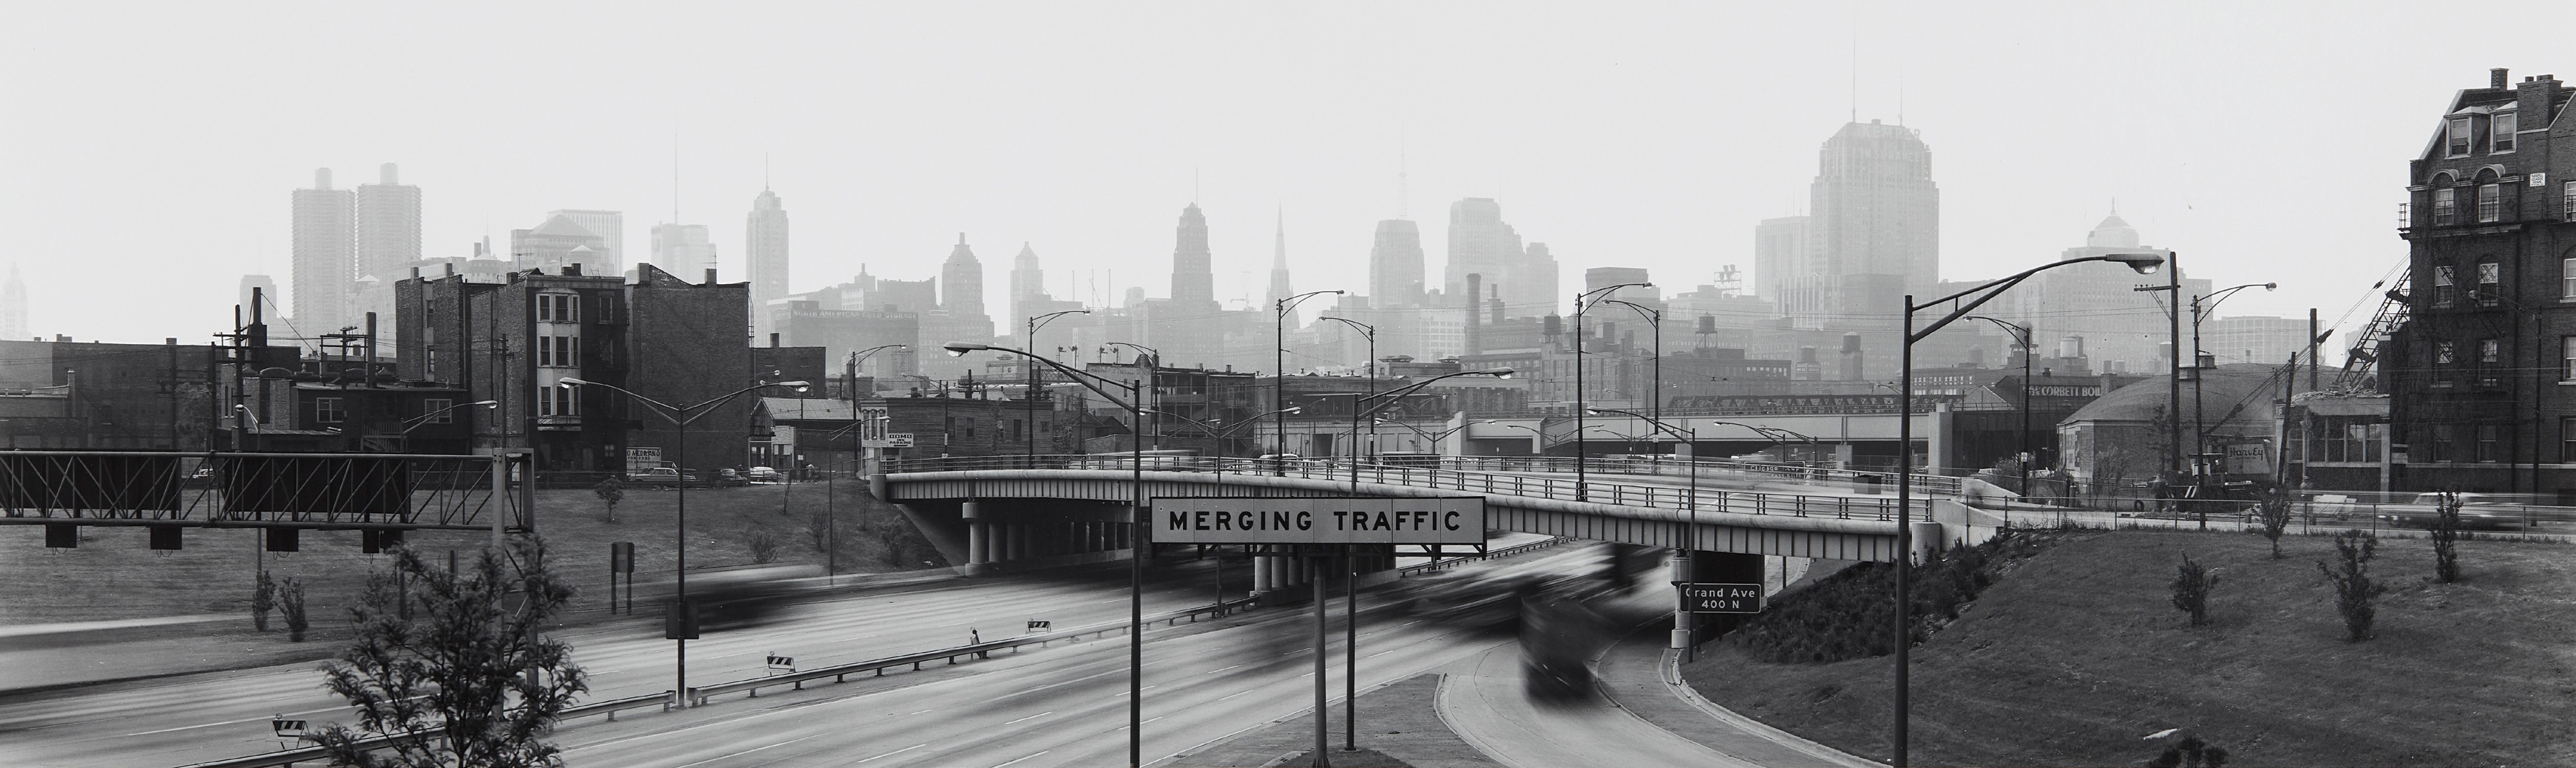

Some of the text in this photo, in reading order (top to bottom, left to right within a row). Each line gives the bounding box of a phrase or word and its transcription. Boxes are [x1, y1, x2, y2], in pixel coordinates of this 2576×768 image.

[2041, 386, 2078, 396] CORBETT
[1170, 511, 1461, 532] MERGING TRAFFIC
[1730, 588, 1756, 597] Ave
[1701, 600, 1739, 608] 400 N
